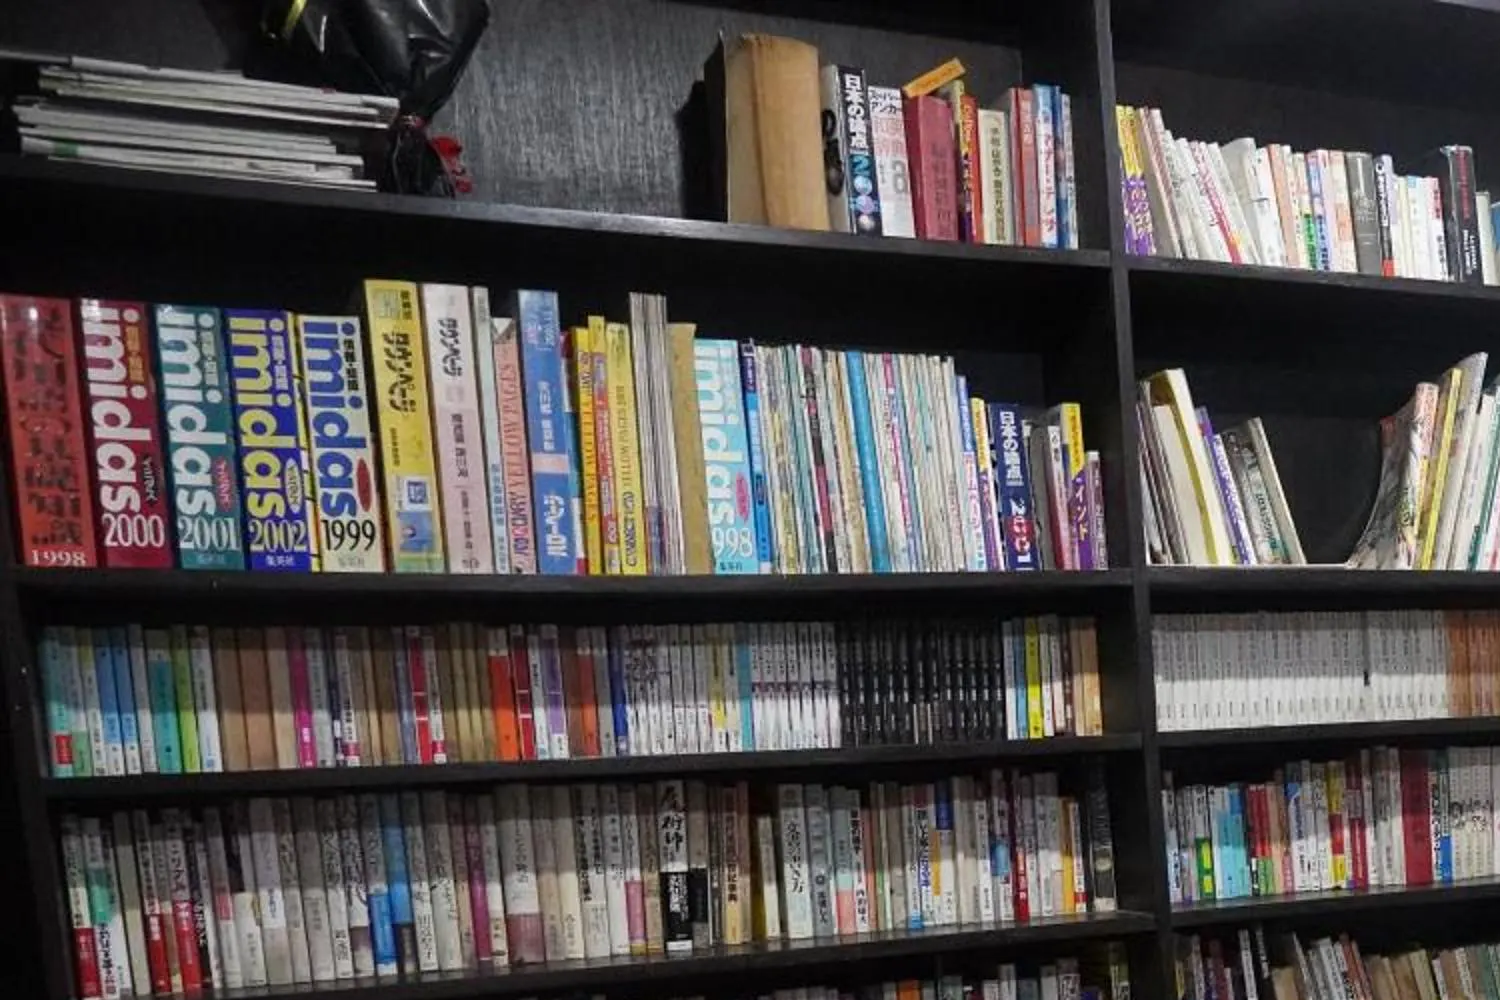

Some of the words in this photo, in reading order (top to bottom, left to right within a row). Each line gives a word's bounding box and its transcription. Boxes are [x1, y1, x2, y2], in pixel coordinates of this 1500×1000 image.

[81, 304, 151, 512] imidas
[156, 305, 227, 516] imidas
[499, 363, 518, 414] PAGES
[229, 317, 295, 518] imidas
[304, 321, 367, 518] imidas
[696, 344, 743, 526] imidas
[503, 418, 526, 488] YELLOW
[103, 513, 166, 547] 2000
[177, 517, 241, 551] 2001
[249, 520, 307, 552] 2002
[321, 520, 376, 551] 1999
[711, 528, 753, 557] 998
[31, 550, 87, 566] 1998
